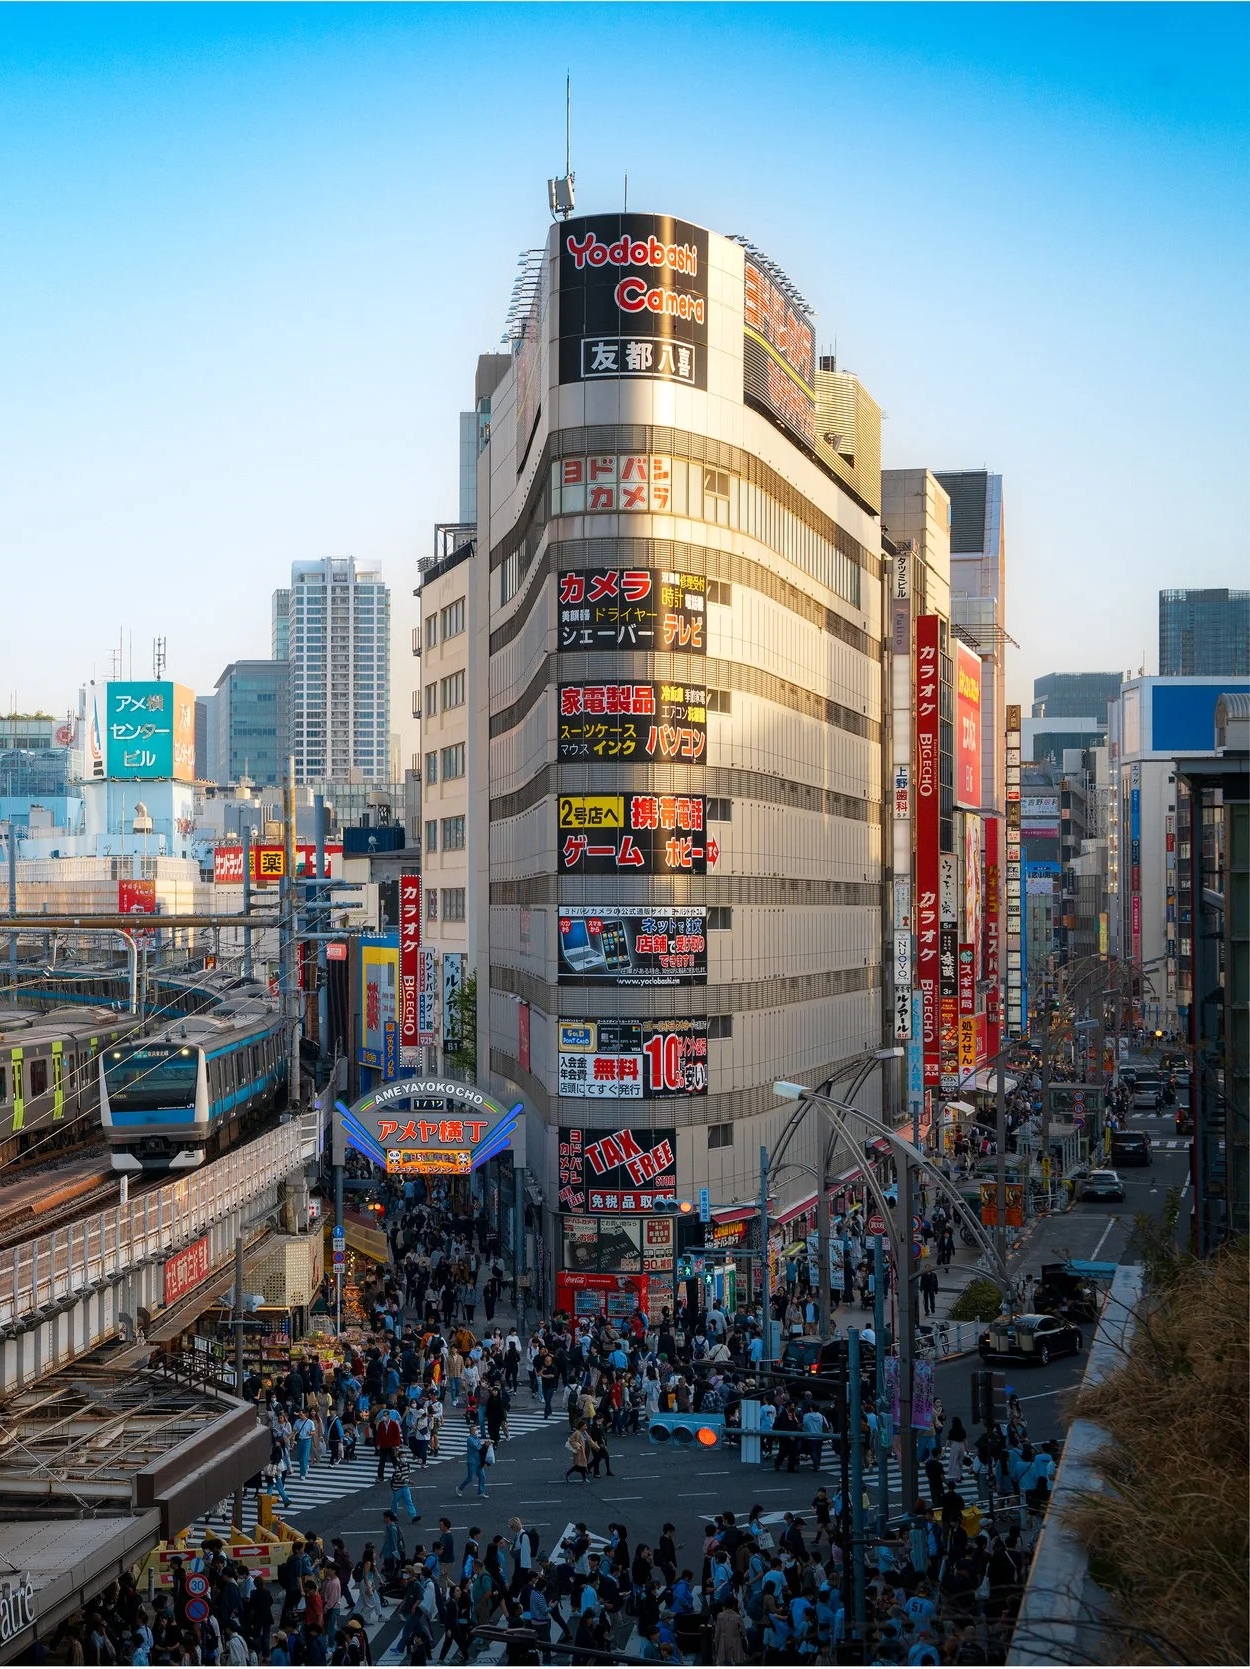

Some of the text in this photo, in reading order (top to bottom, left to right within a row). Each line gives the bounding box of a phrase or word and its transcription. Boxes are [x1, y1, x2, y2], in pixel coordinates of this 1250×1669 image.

[566, 231, 698, 277] Yodobashi
[614, 277, 705, 325] Camera
[590, 340, 691, 377] 友都八喜
[562, 457, 669, 484] ヨドバシ
[589, 486, 669, 509] カメラ
[560, 571, 651, 604] カメラ
[897, 557, 908, 598] タツミビル
[662, 587, 684, 608] 時計
[594, 607, 658, 622] ドライヤー
[562, 624, 655, 646] シェーバー
[664, 613, 703, 648] テレビ
[919, 646, 936, 717] カラオケ
[115, 695, 164, 713] アメ横
[560, 684, 656, 716] 家電製品
[661, 705, 688, 720] エアコン
[110, 722, 170, 740] センター
[560, 724, 637, 739] スーツケース
[646, 724, 706, 758] パソコン
[124, 750, 156, 768] ビル
[560, 744, 590, 756] マウス
[592, 740, 636, 756] インク
[919, 734, 932, 797] BIG ECHO
[895, 766, 908, 812] 上野歯科
[561, 800, 620, 826] 2号店へ
[630, 796, 703, 830] 携帯電話
[262, 853, 282, 872] 薬
[562, 836, 644, 867] ゲーム
[666, 837, 704, 867] ホビー
[403, 886, 418, 953] カラオケ
[564, 908, 668, 916] ヨドバシカメラの公式通販サイト
[641, 918, 702, 934] ネットで注文
[918, 892, 936, 962] カラオケ
[636, 934, 705, 954] 店舗で受け取り
[898, 940, 908, 978] NUOVO
[960, 965, 973, 1008] スギ薬局
[403, 976, 415, 1036] BIG ECHO
[896, 994, 909, 1032] ルノアール
[921, 980, 934, 1042] BIG ECHO
[962, 1021, 972, 1064] 処方せん
[560, 1056, 587, 1068] 入会金
[560, 1070, 587, 1081] 年会費
[593, 1058, 639, 1081] 無料
[374, 1082, 484, 1105] AMEYAYOKOCHO
[560, 1083, 641, 1096] 店頭にてすぐ発行
[377, 1120, 488, 1143] アメヤ横丁
[560, 1143, 570, 1184] カメラ
[570, 1130, 582, 1184] ヨドバシ
[584, 1128, 644, 1176] TAX
[626, 1138, 674, 1187] FREE
[558, 1185, 574, 1202] TAX
[567, 1192, 586, 1208] FREE
[624, 1250, 639, 1258] VISA
[191, 1580, 204, 1590] 30
[0, 1571, 35, 1640] atré
[912, 1602, 923, 1613] 51
